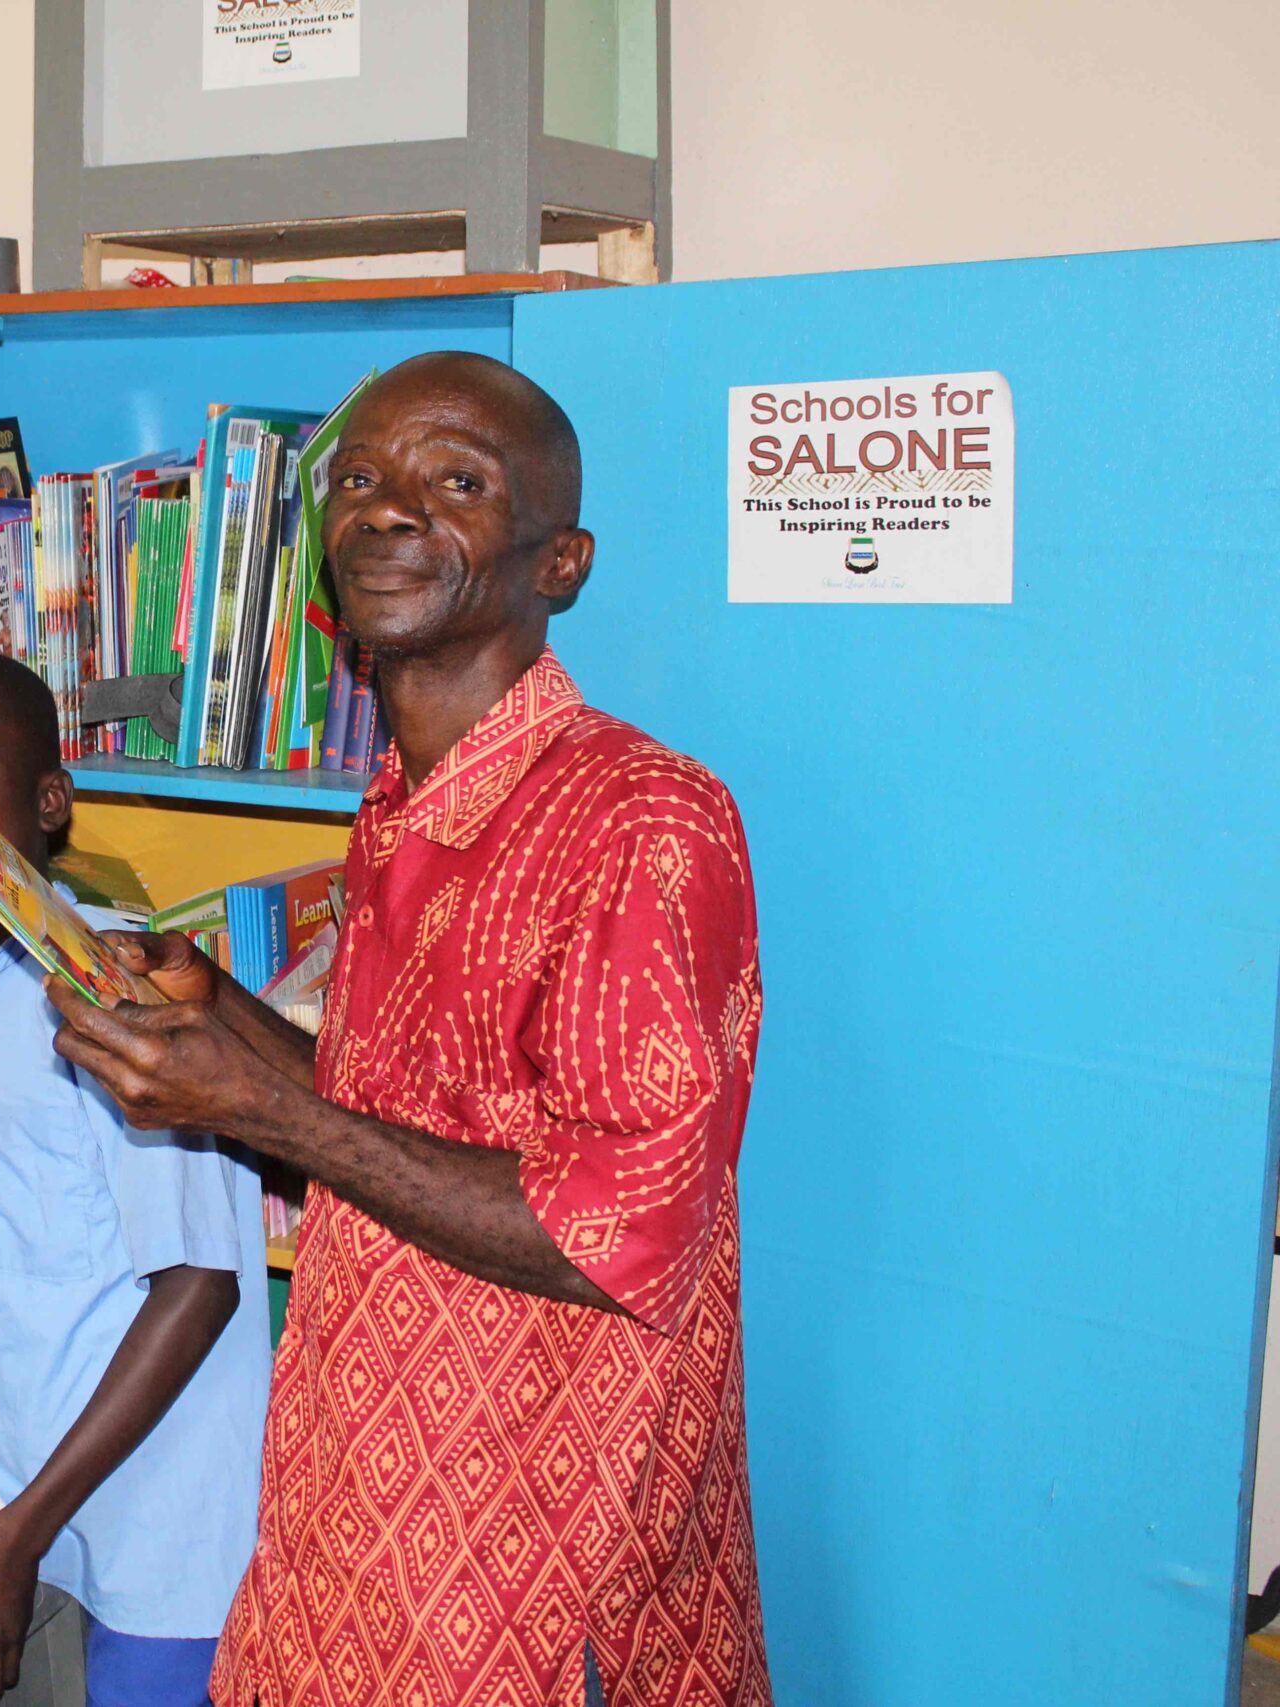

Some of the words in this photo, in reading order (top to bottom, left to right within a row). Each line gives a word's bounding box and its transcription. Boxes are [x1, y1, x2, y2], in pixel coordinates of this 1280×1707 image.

[214, 25, 237, 34] This
[239, 22, 276, 32] School
[291, 16, 324, 26] Proud
[328, 13, 339, 21] to
[342, 12, 355, 20] be
[235, 31, 286, 44] Inspiring
[288, 27, 332, 38] Readers
[750, 386, 918, 425] Schools
[931, 382, 994, 417] for
[747, 426, 992, 477] SALONE
[743, 499, 783, 512] This
[787, 497, 850, 511] School
[855, 497, 870, 510] is
[876, 496, 936, 510] Proud
[942, 495, 962, 508] to
[968, 494, 992, 508] be
[779, 518, 867, 534] Inspiring
[871, 517, 950, 531] Readers
[295, 898, 332, 928] Learn
[271, 905, 279, 953] Learn
